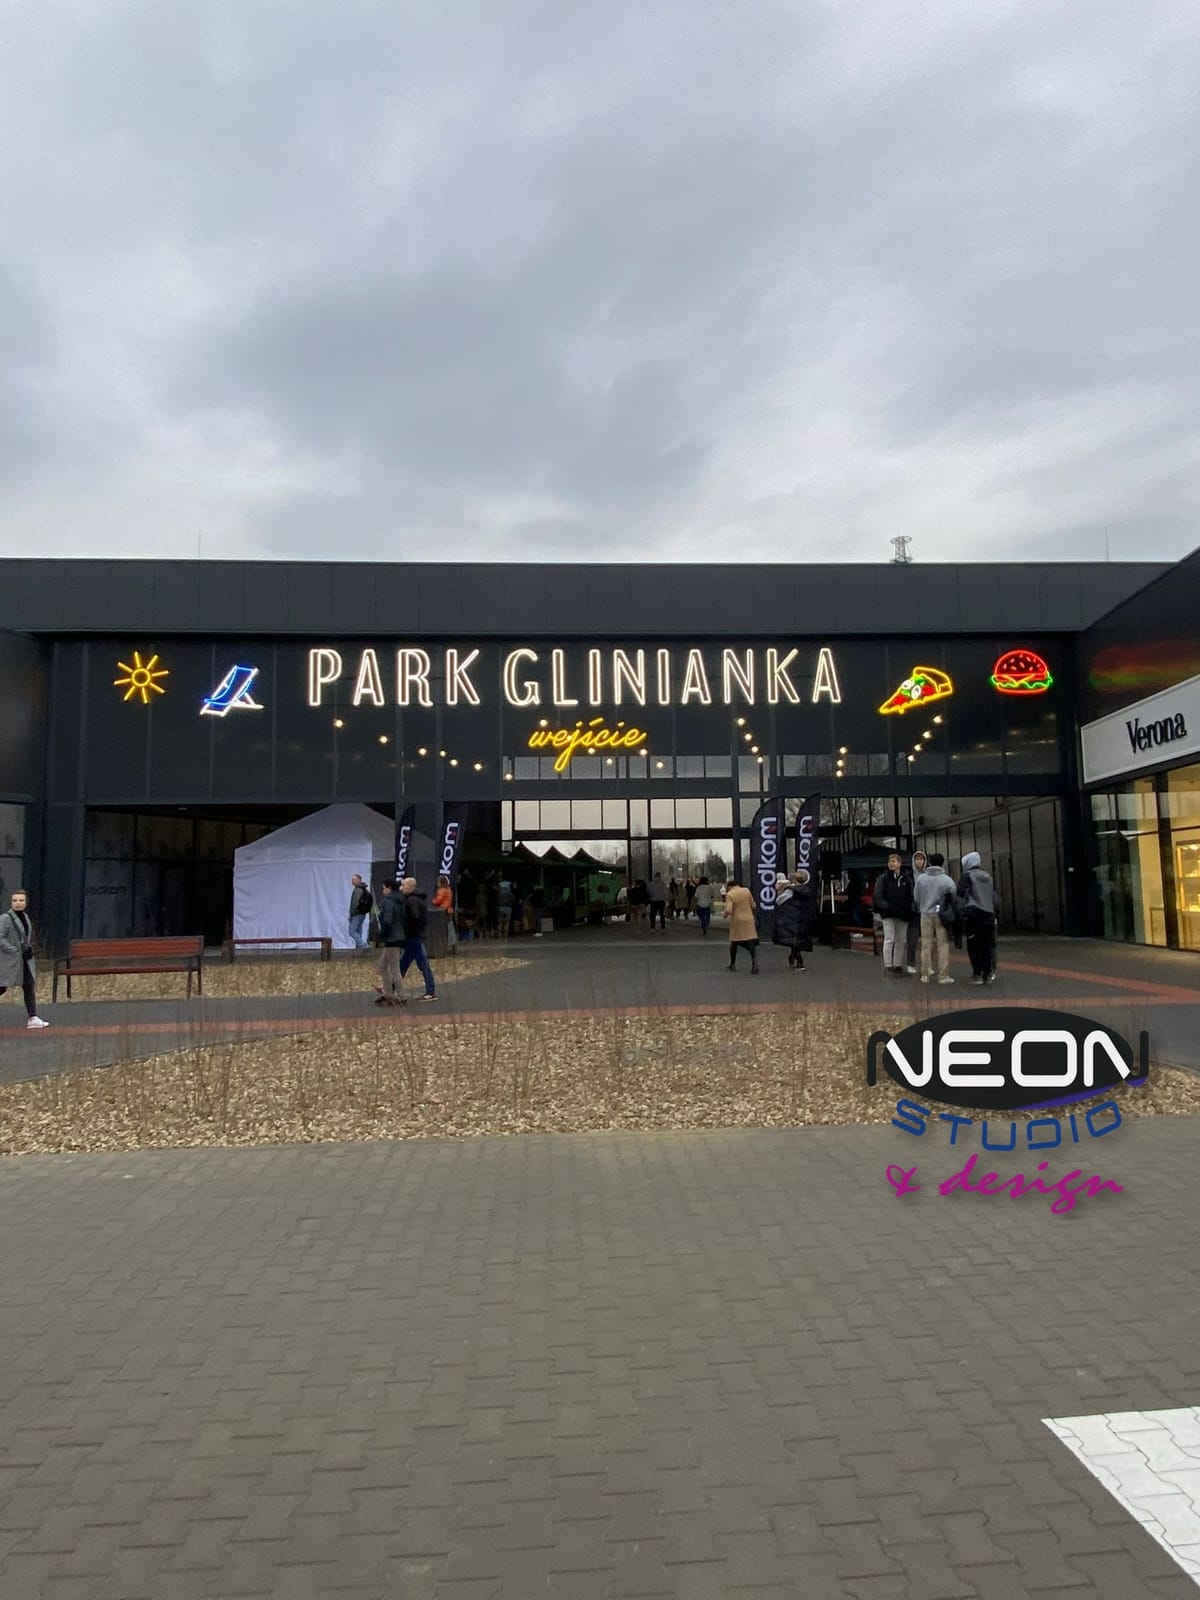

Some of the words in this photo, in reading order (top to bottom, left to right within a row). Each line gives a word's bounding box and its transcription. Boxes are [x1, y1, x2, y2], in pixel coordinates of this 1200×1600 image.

[309, 648, 480, 706] PARK
[503, 648, 842, 705] GLINIANKA
[528, 717, 647, 772] wejście
[1126, 713, 1187, 754] Verona
[757, 816, 777, 910] redkom
